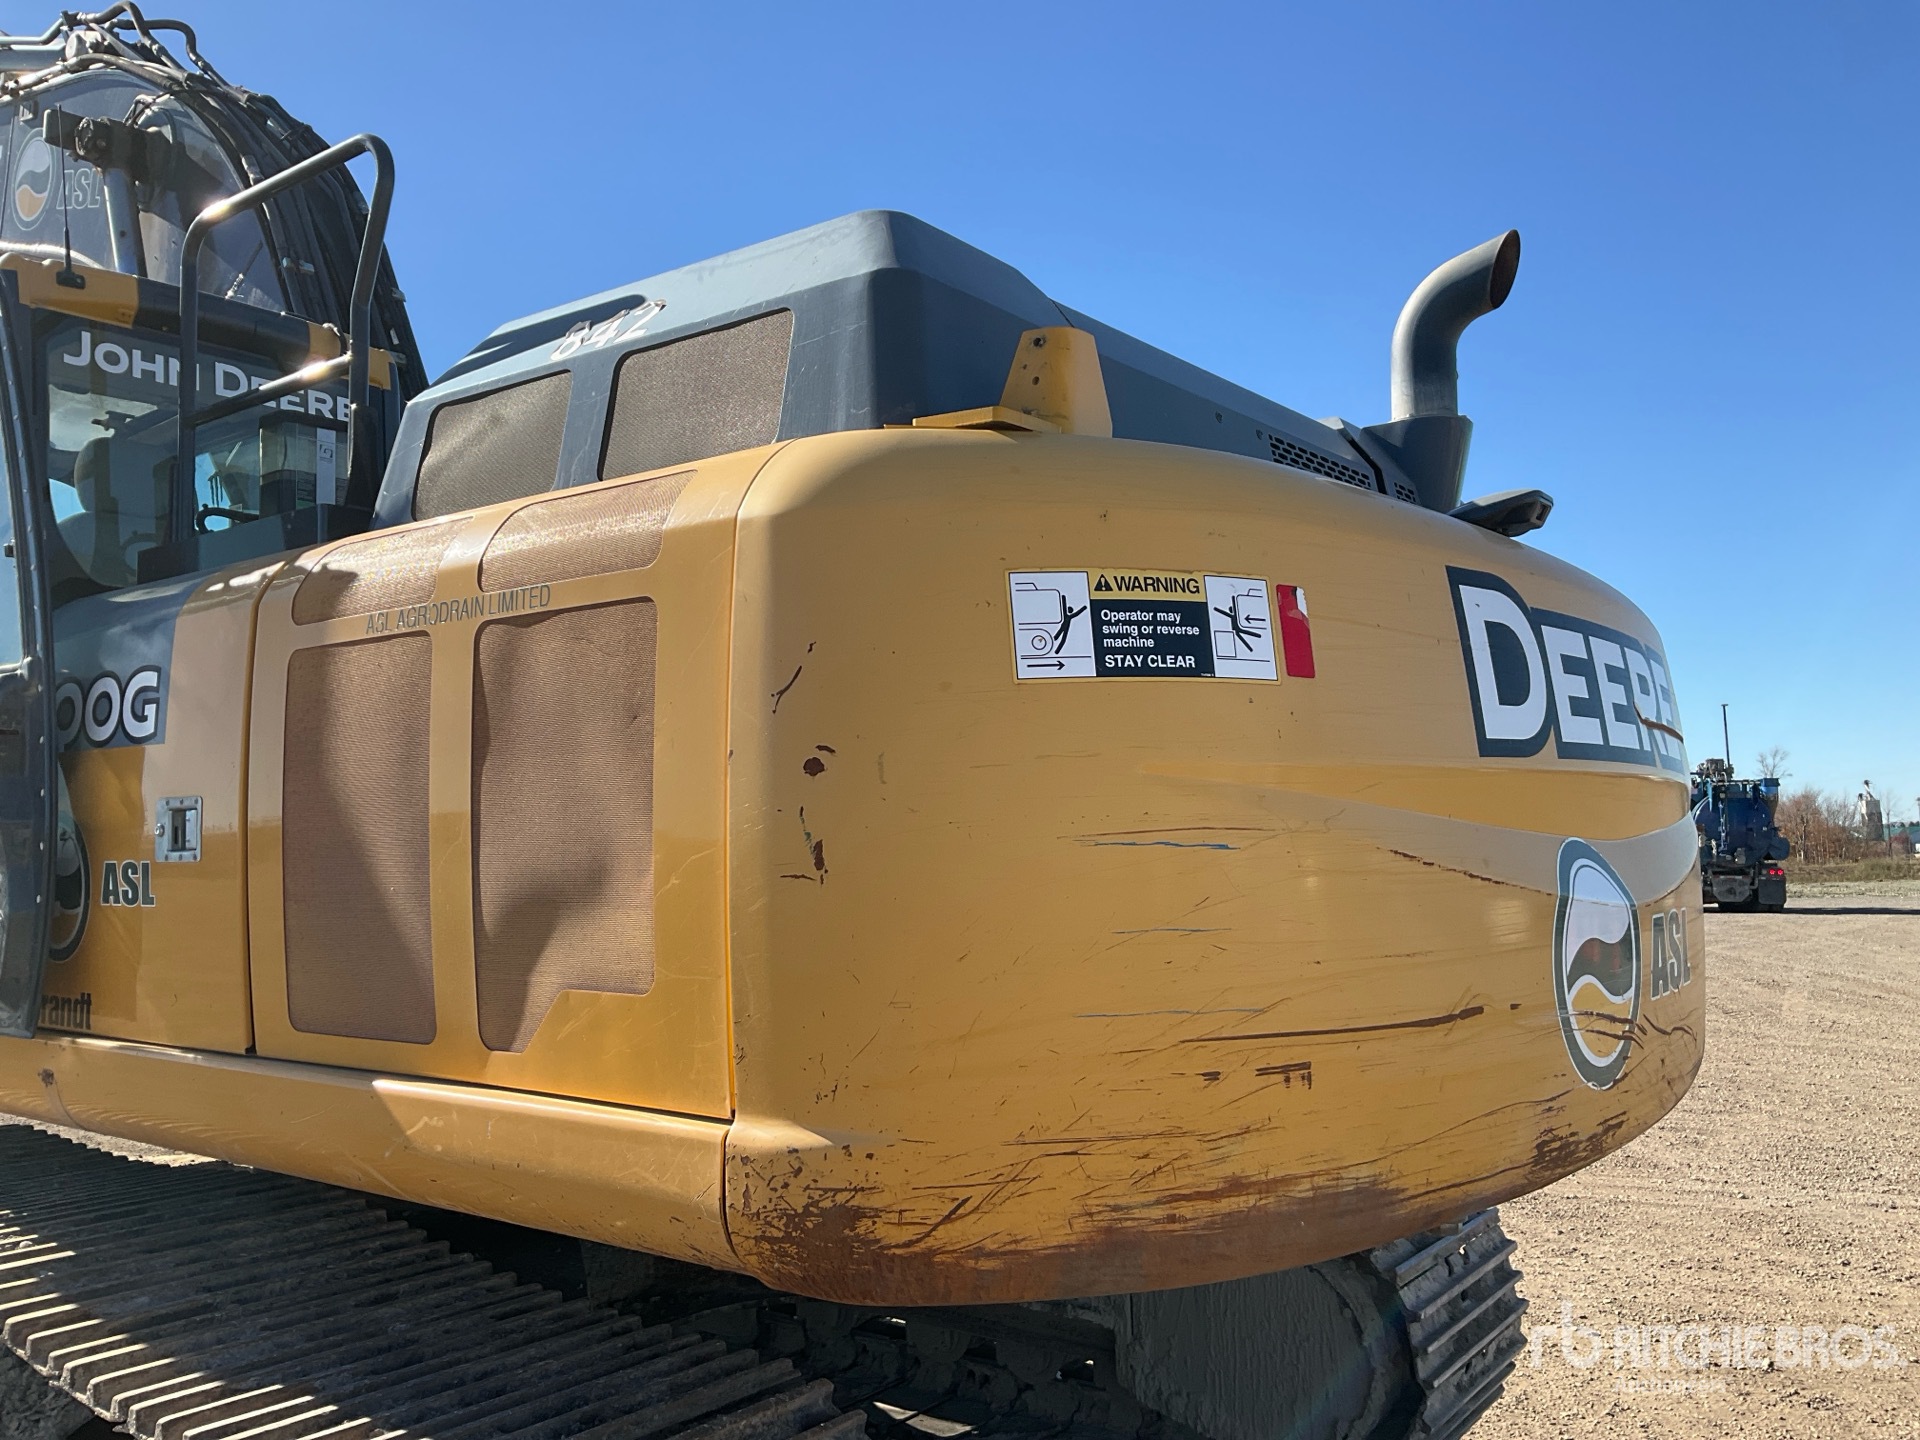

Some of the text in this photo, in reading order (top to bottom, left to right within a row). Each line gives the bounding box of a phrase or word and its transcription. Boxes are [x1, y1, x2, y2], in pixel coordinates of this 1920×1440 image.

[56, 168, 102, 210] ASL
[1114, 575, 1200, 594] WARNING
[365, 584, 551, 635] ASL AGRODRAIN LIMITED
[1100, 609, 1181, 624] Operator may
[1102, 623, 1200, 637] swing or reverse
[1103, 636, 1155, 648] machine
[1104, 655, 1196, 668] STAY CLEAR
[1458, 584, 1684, 762] DEERE
[101, 859, 156, 907] ASL
[1650, 907, 1691, 1000] ASL
